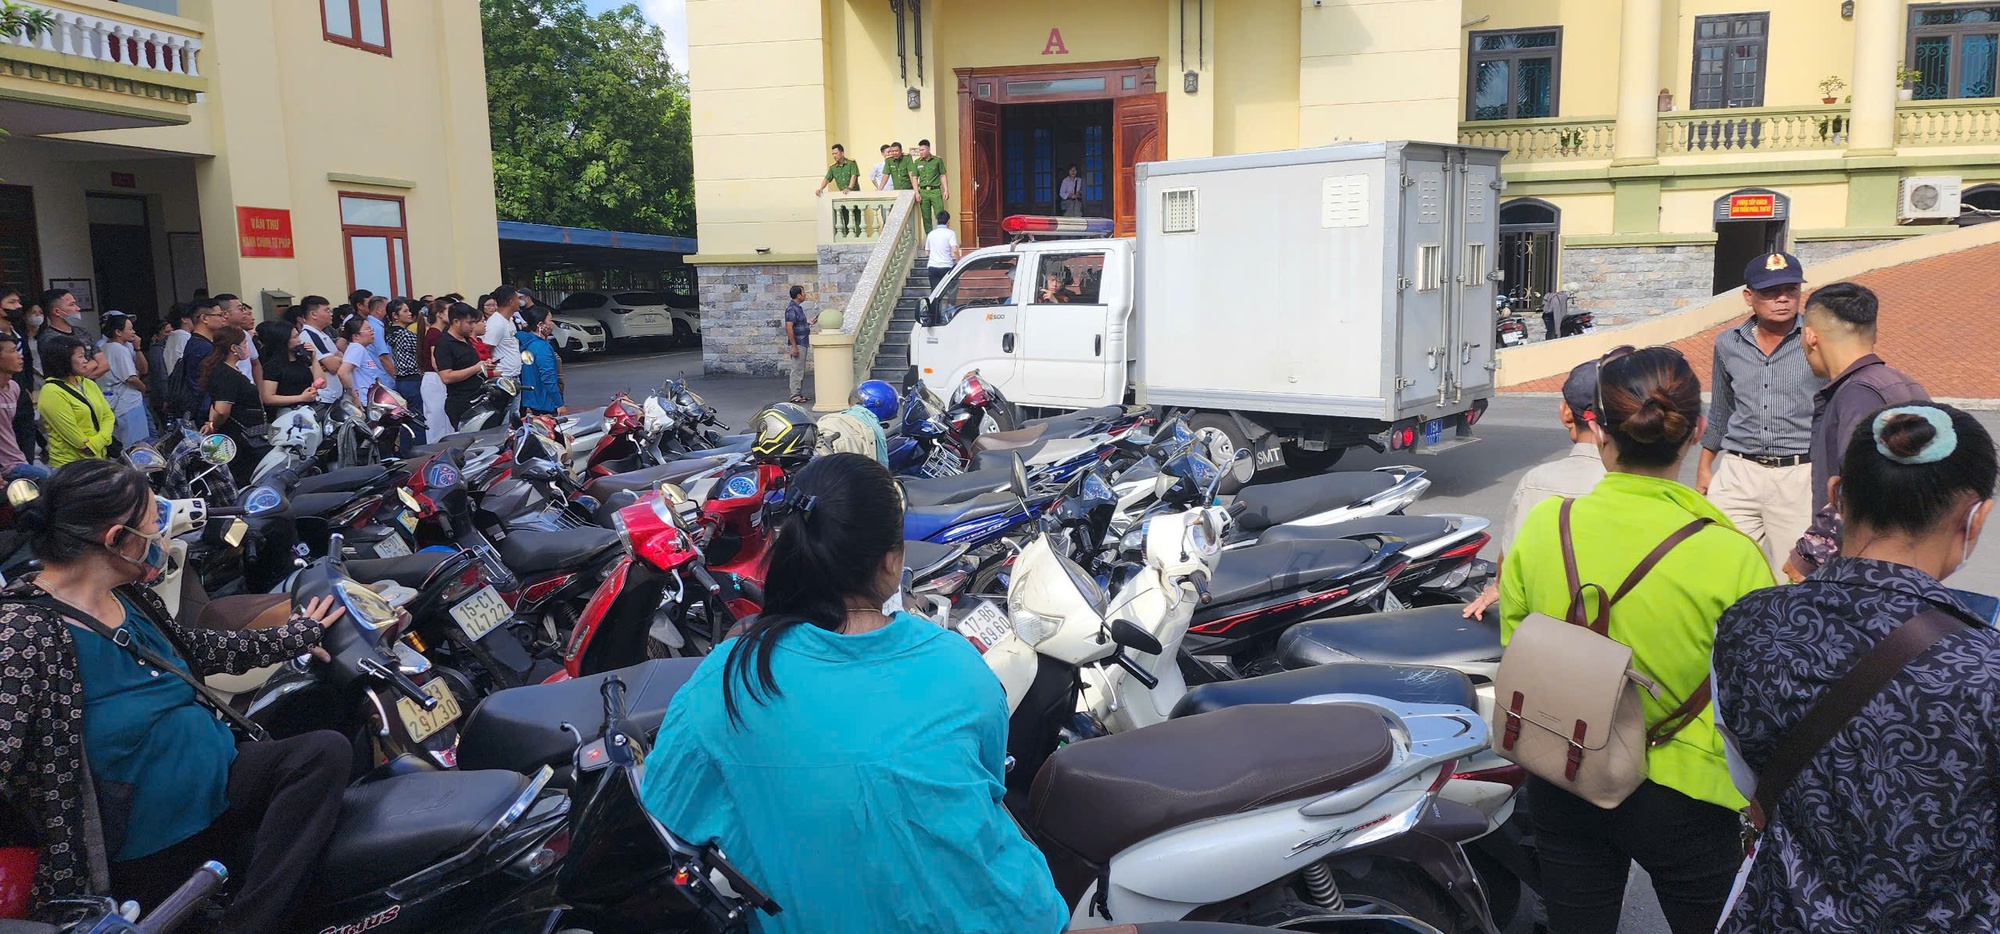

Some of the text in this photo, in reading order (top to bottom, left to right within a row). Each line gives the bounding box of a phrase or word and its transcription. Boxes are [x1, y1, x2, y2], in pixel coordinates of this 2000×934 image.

[1041, 27, 1069, 55] A
[1257, 447, 1280, 465] SMT
[460, 591, 494, 620] 15-C1
[467, 604, 510, 636] 147.22
[980, 616, 1010, 646] 69.60
